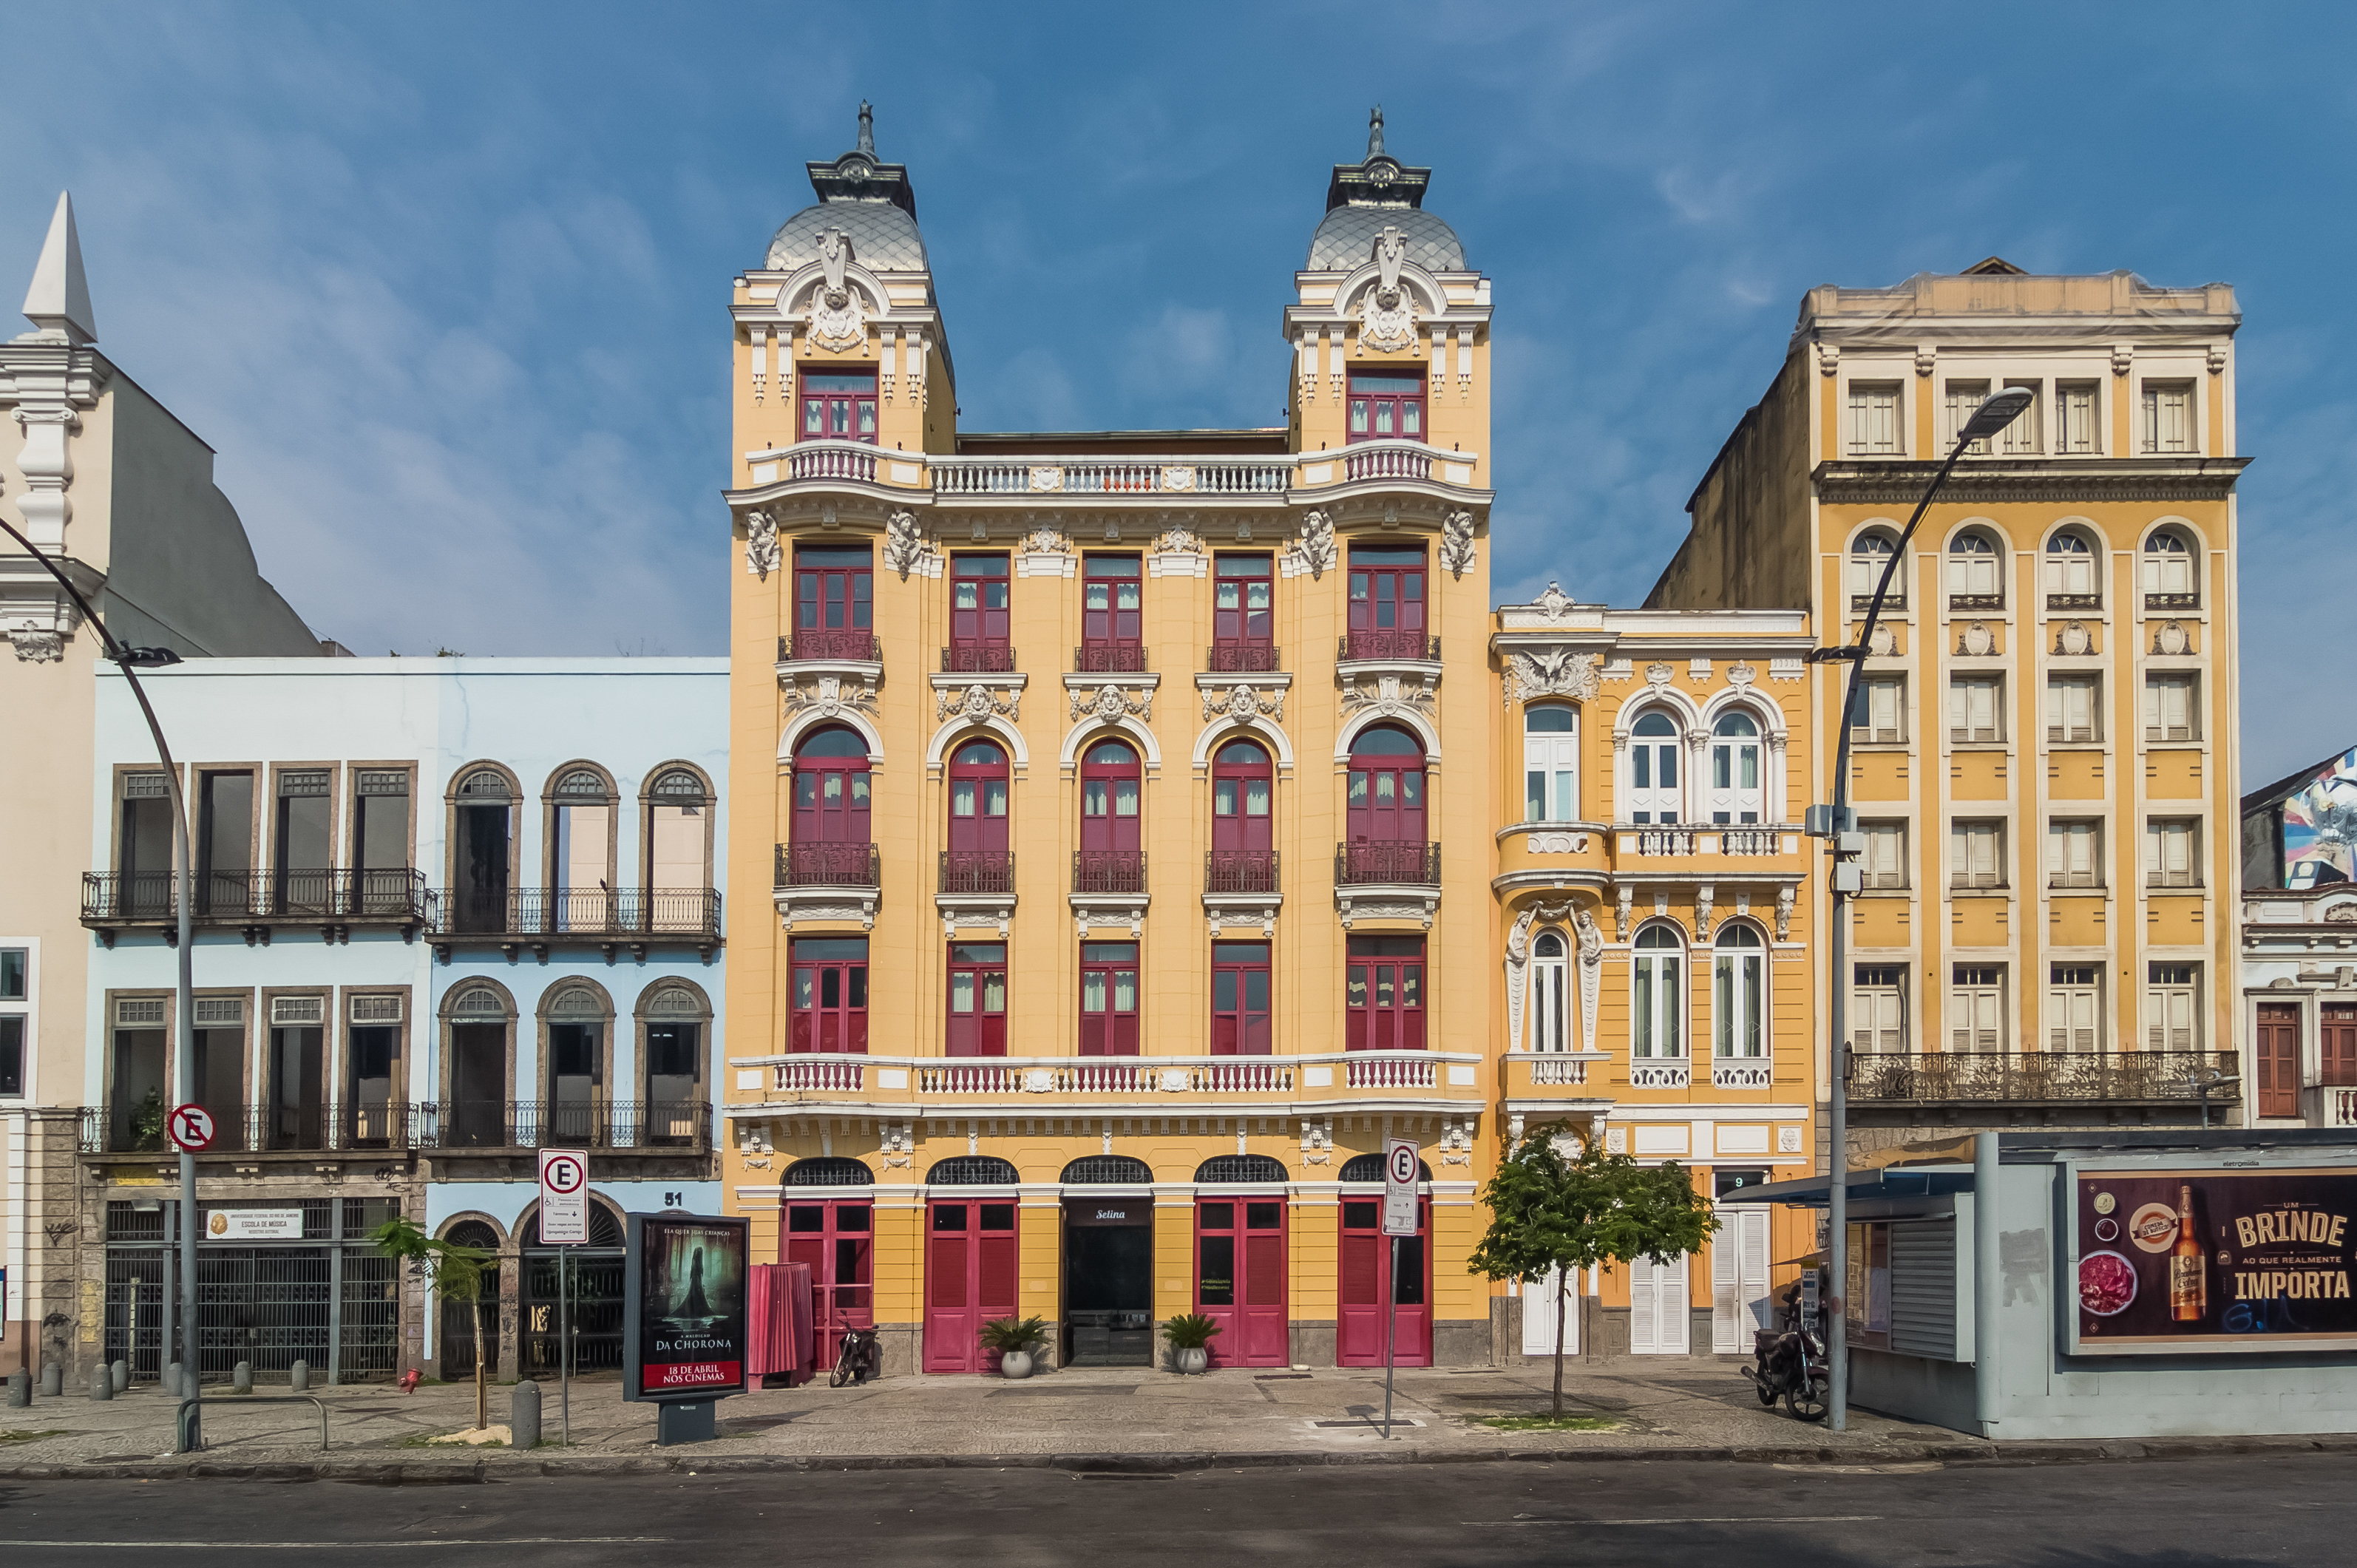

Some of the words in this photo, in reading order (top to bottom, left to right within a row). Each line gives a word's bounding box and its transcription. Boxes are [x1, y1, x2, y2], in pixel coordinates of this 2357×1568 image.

[1398, 1153, 1408, 1175] E
[557, 1164, 570, 1185] E
[1735, 1177, 1743, 1187] 9
[664, 1192, 682, 1206] 51
[1096, 1209, 1125, 1219] Selina
[268, 1219, 288, 1227] MÚSICA
[2235, 1211, 2348, 1248] BRINDE
[2234, 1271, 2350, 1300] IMPORTA
[656, 1340, 671, 1351] DA
[674, 1339, 731, 1350] CHORONA
[669, 1367, 678, 1375] 18
[680, 1365, 693, 1374] DE
[693, 1365, 719, 1374] ABRIL
[663, 1374, 683, 1384] NOS
[685, 1372, 725, 1382] CINEMAS
